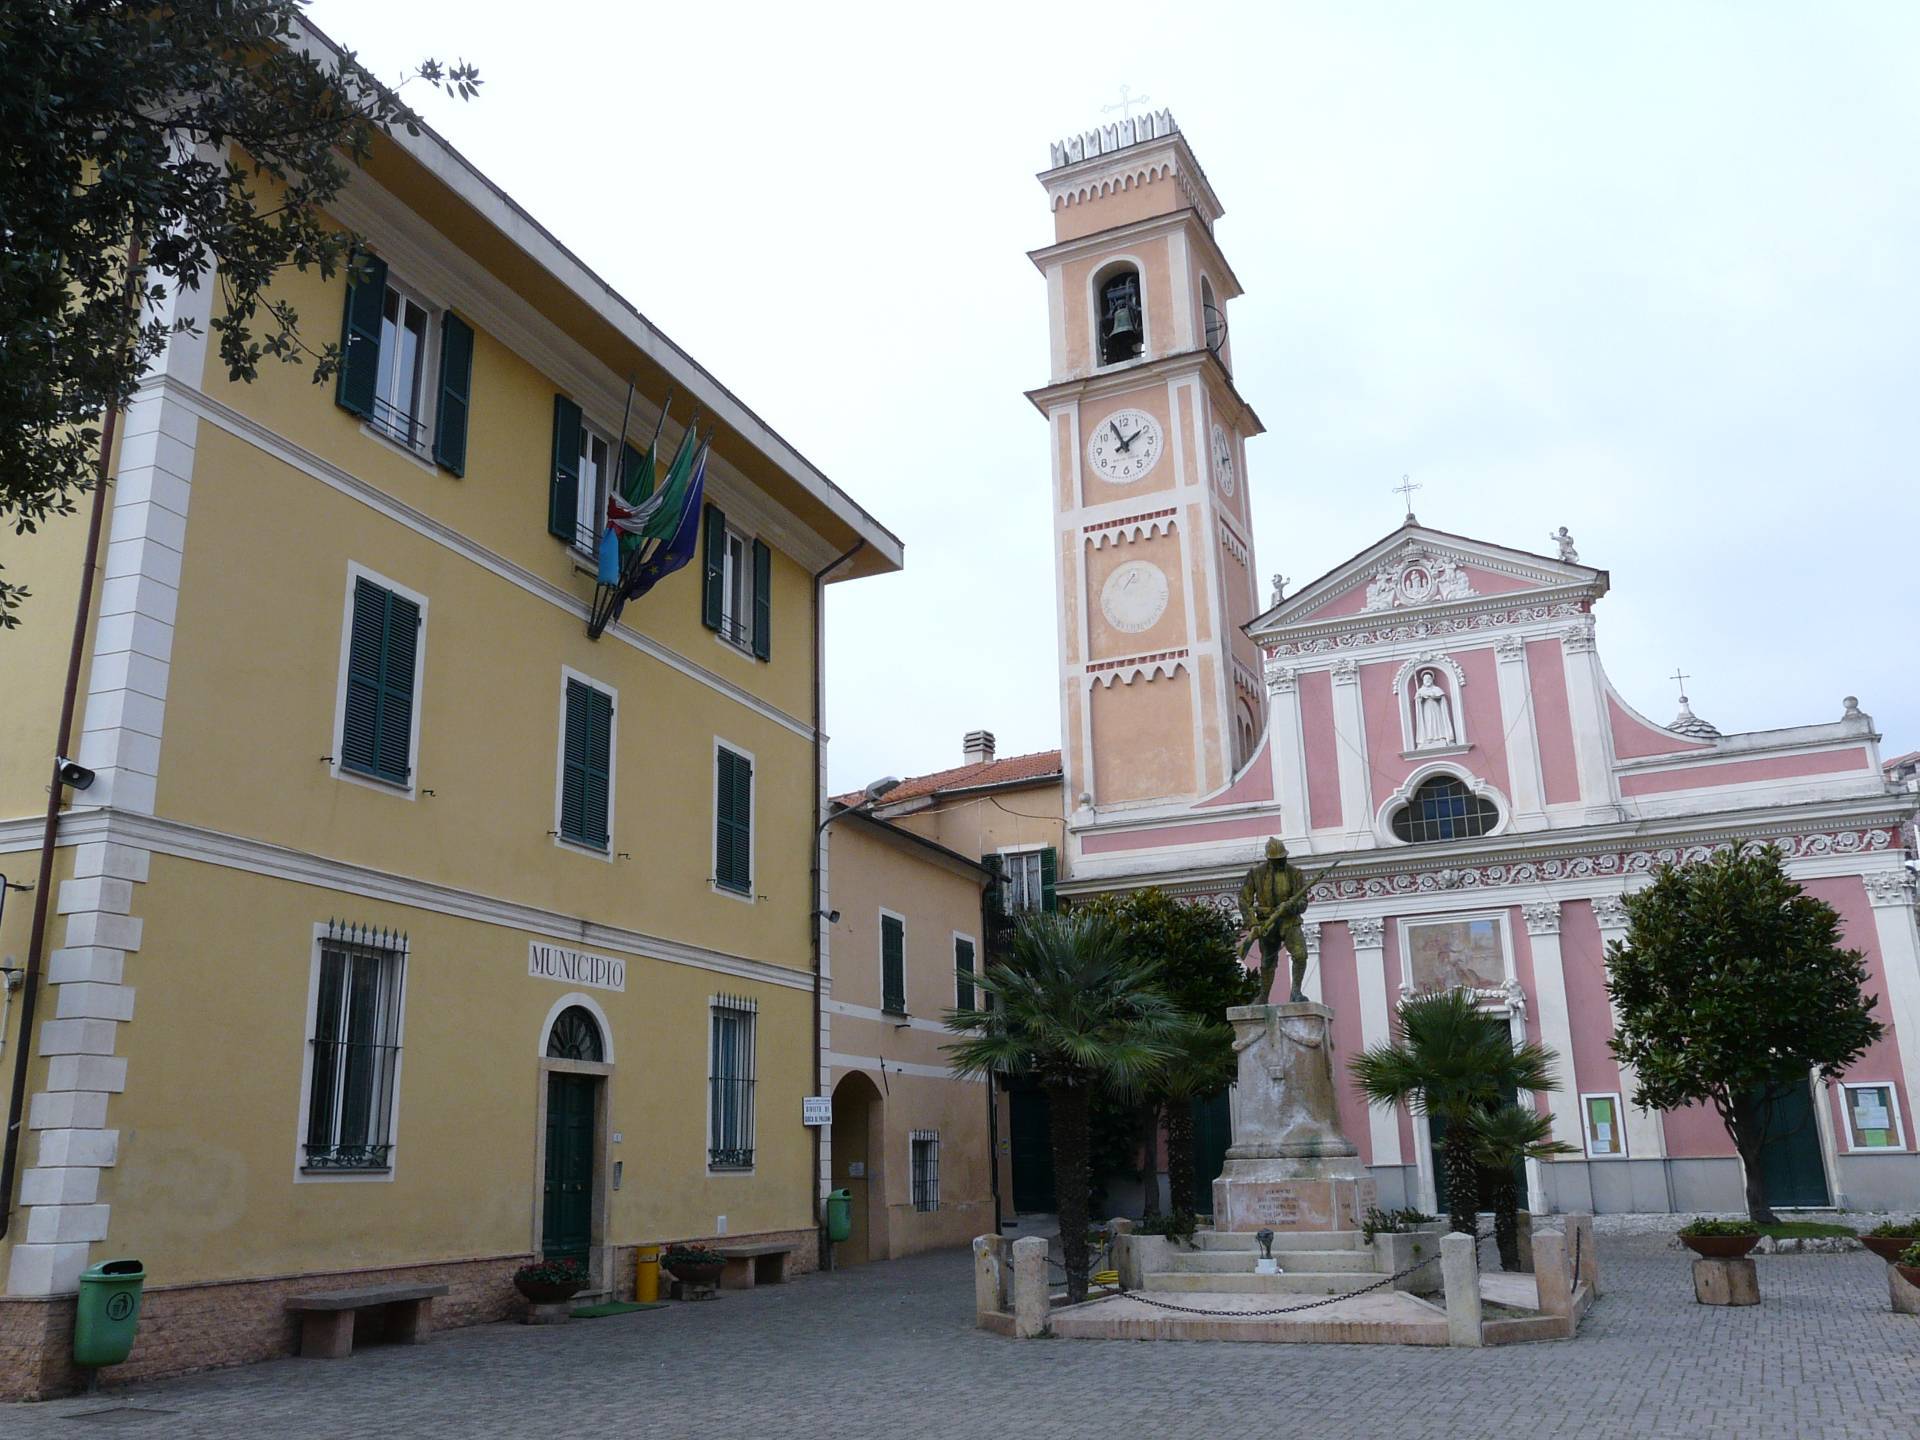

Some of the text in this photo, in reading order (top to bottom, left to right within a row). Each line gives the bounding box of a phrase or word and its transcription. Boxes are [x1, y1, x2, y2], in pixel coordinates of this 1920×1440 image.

[1119, 418, 1129, 428] 12
[1099, 433, 1109, 443] 10
[1147, 435, 1154, 445] 3
[1096, 447, 1103, 456] 9
[1144, 449, 1151, 458] 4
[1100, 458, 1107, 468] 8
[1136, 459, 1143, 469] 5
[1110, 465, 1117, 474] 7
[1123, 466, 1130, 475] 6
[531, 945, 623, 987] MUNICIPIO
